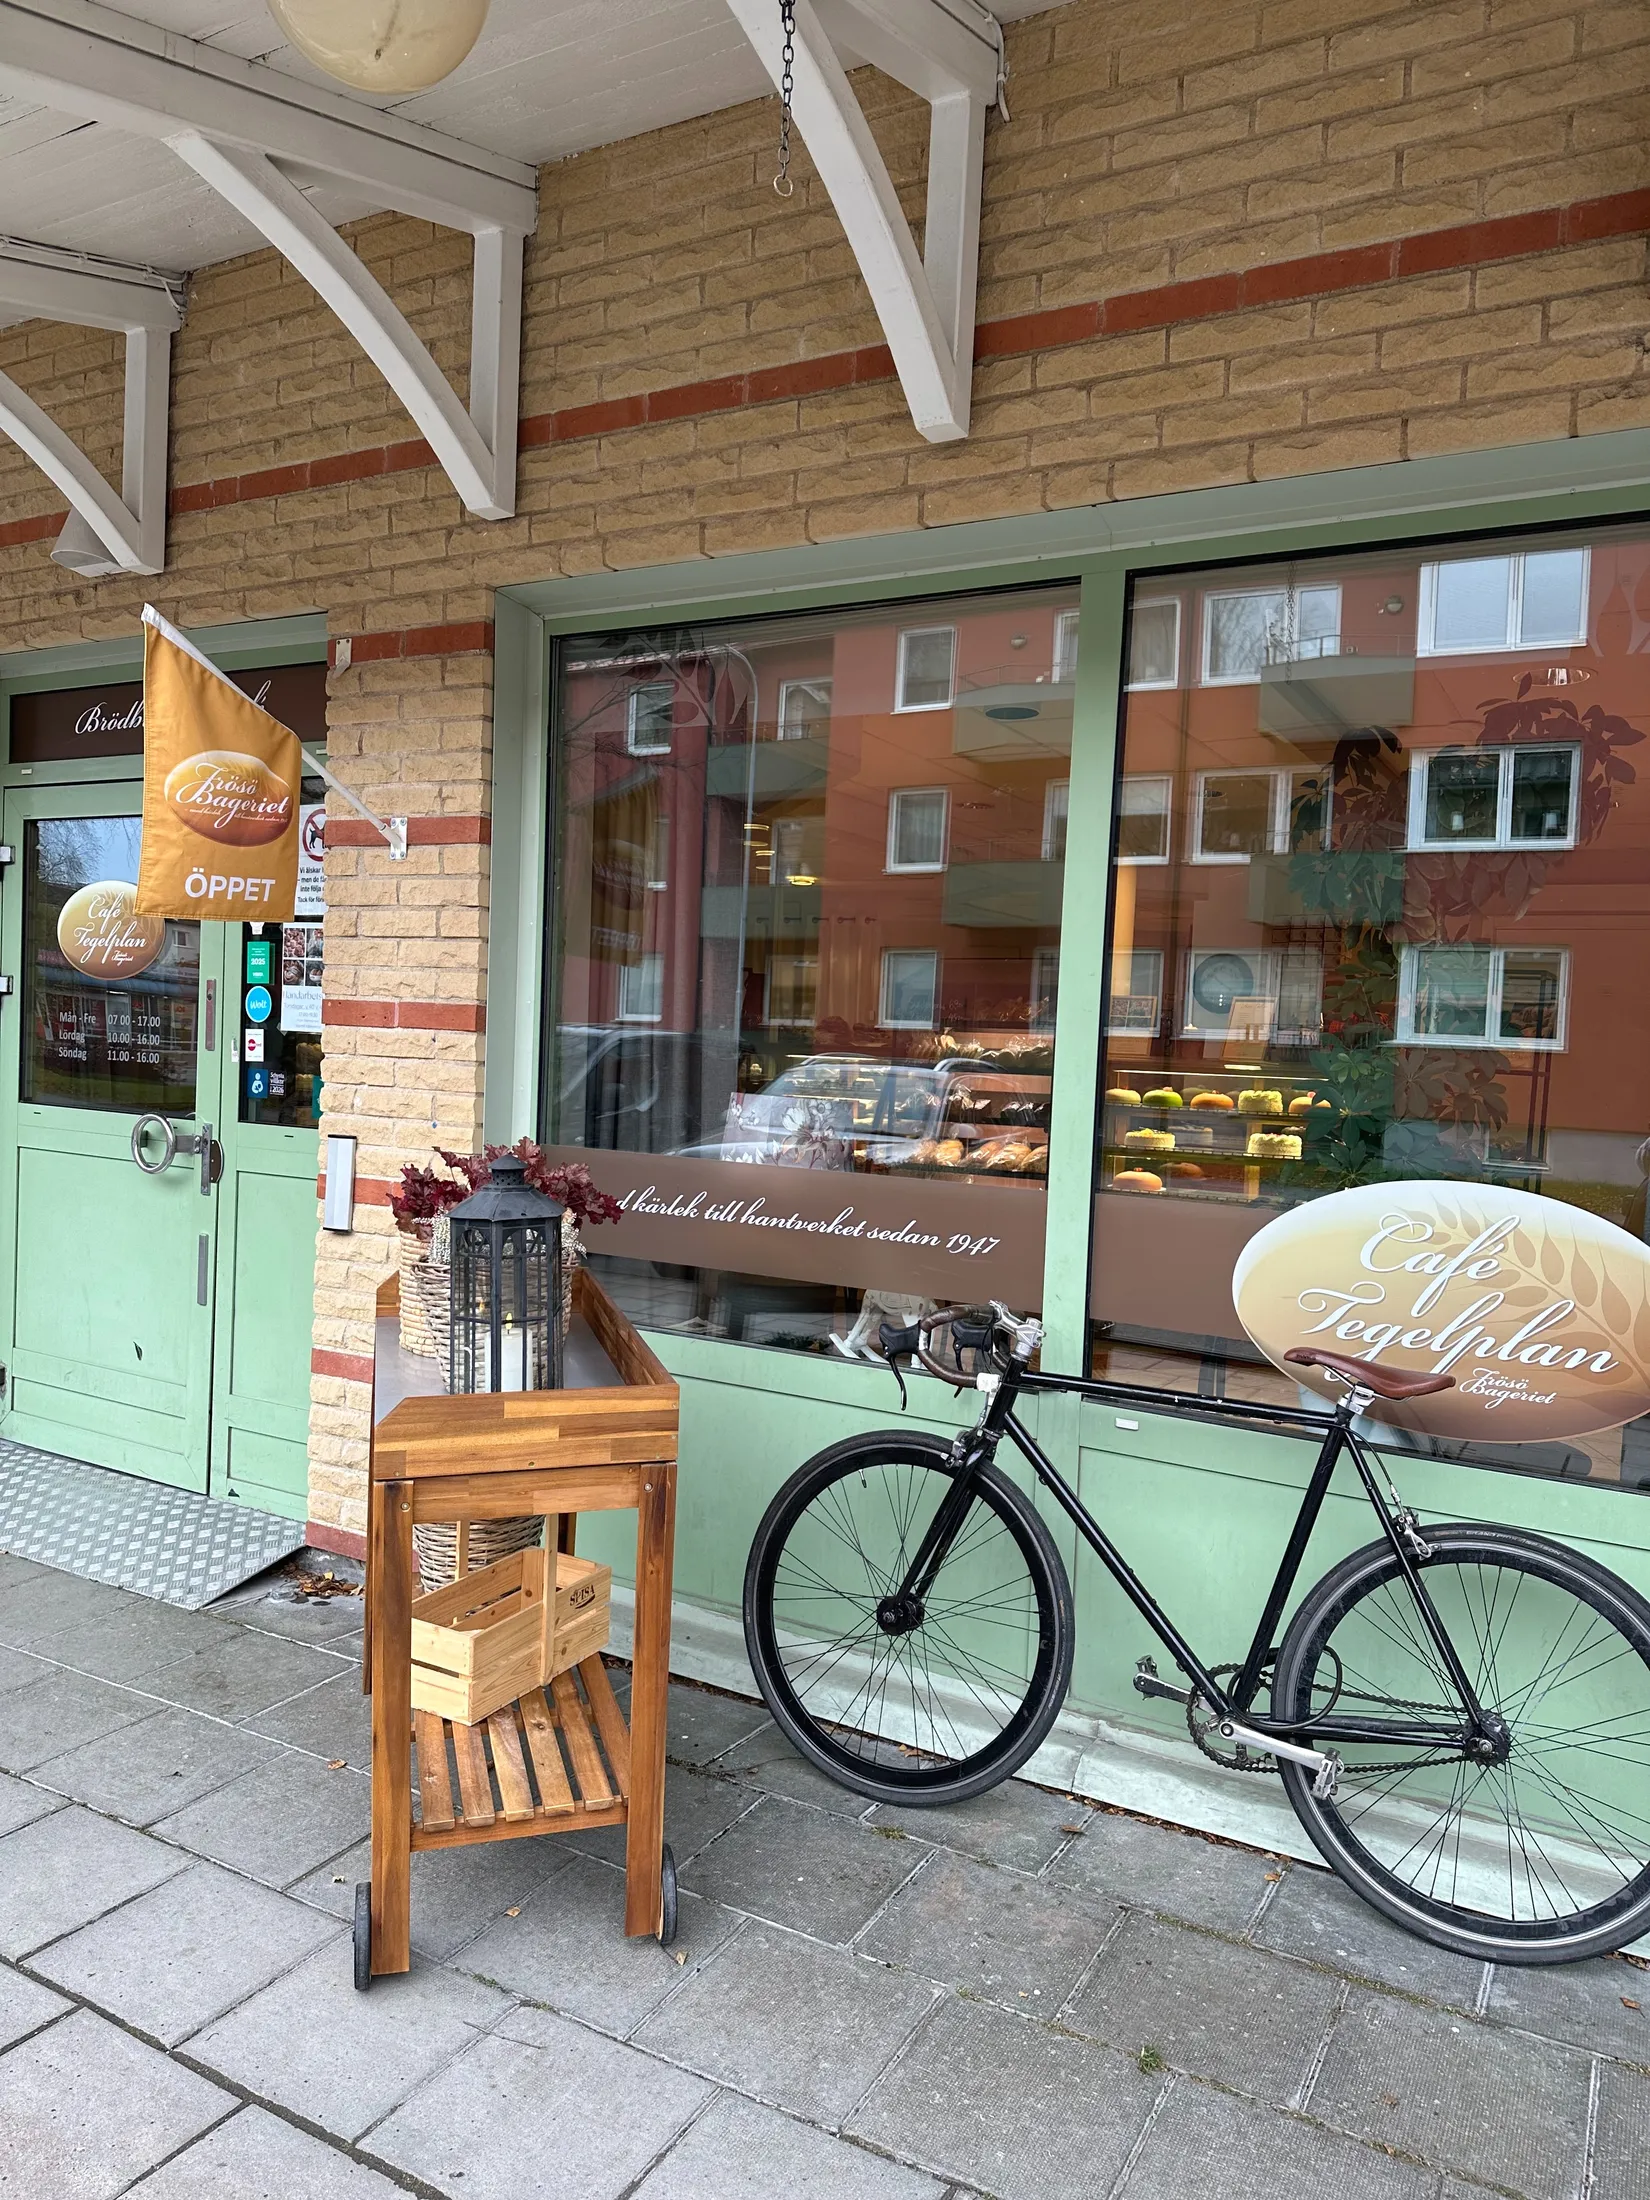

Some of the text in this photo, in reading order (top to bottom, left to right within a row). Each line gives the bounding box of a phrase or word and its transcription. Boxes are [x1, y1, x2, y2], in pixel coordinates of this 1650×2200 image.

[75, 701, 144, 734] Brödb
[195, 763, 258, 798] Frösö
[175, 780, 290, 829] Bageriet
[185, 867, 276, 902] ÖPPET
[88, 891, 124, 935] Café
[74, 921, 147, 964] Tegelplan
[60, 1011, 77, 1023] Mån
[84, 1013, 97, 1024] Fre
[138, 1016, 161, 1027] 17.00
[250, 1000, 267, 1009] Wolt
[58, 1046, 87, 1061] Söndag
[107, 1050, 130, 1061] 11.00
[136, 1052, 160, 1063] 16.00
[59, 1029, 86, 1043] Lördag
[107, 1032, 130, 1043] 10.00
[137, 1034, 160, 1045] 16.00
[632, 1186, 707, 1219] kärlek
[704, 1200, 737, 1222] till
[740, 1197, 865, 1237] hantverket
[866, 1219, 941, 1248] sedan
[946, 1233, 1001, 1256] 1947
[1360, 1211, 1521, 1318] Café
[1297, 1281, 1620, 1382] Tegelplan
[1459, 1377, 1555, 1410] Bageriet
[1470, 1367, 1530, 1393] Frösö
